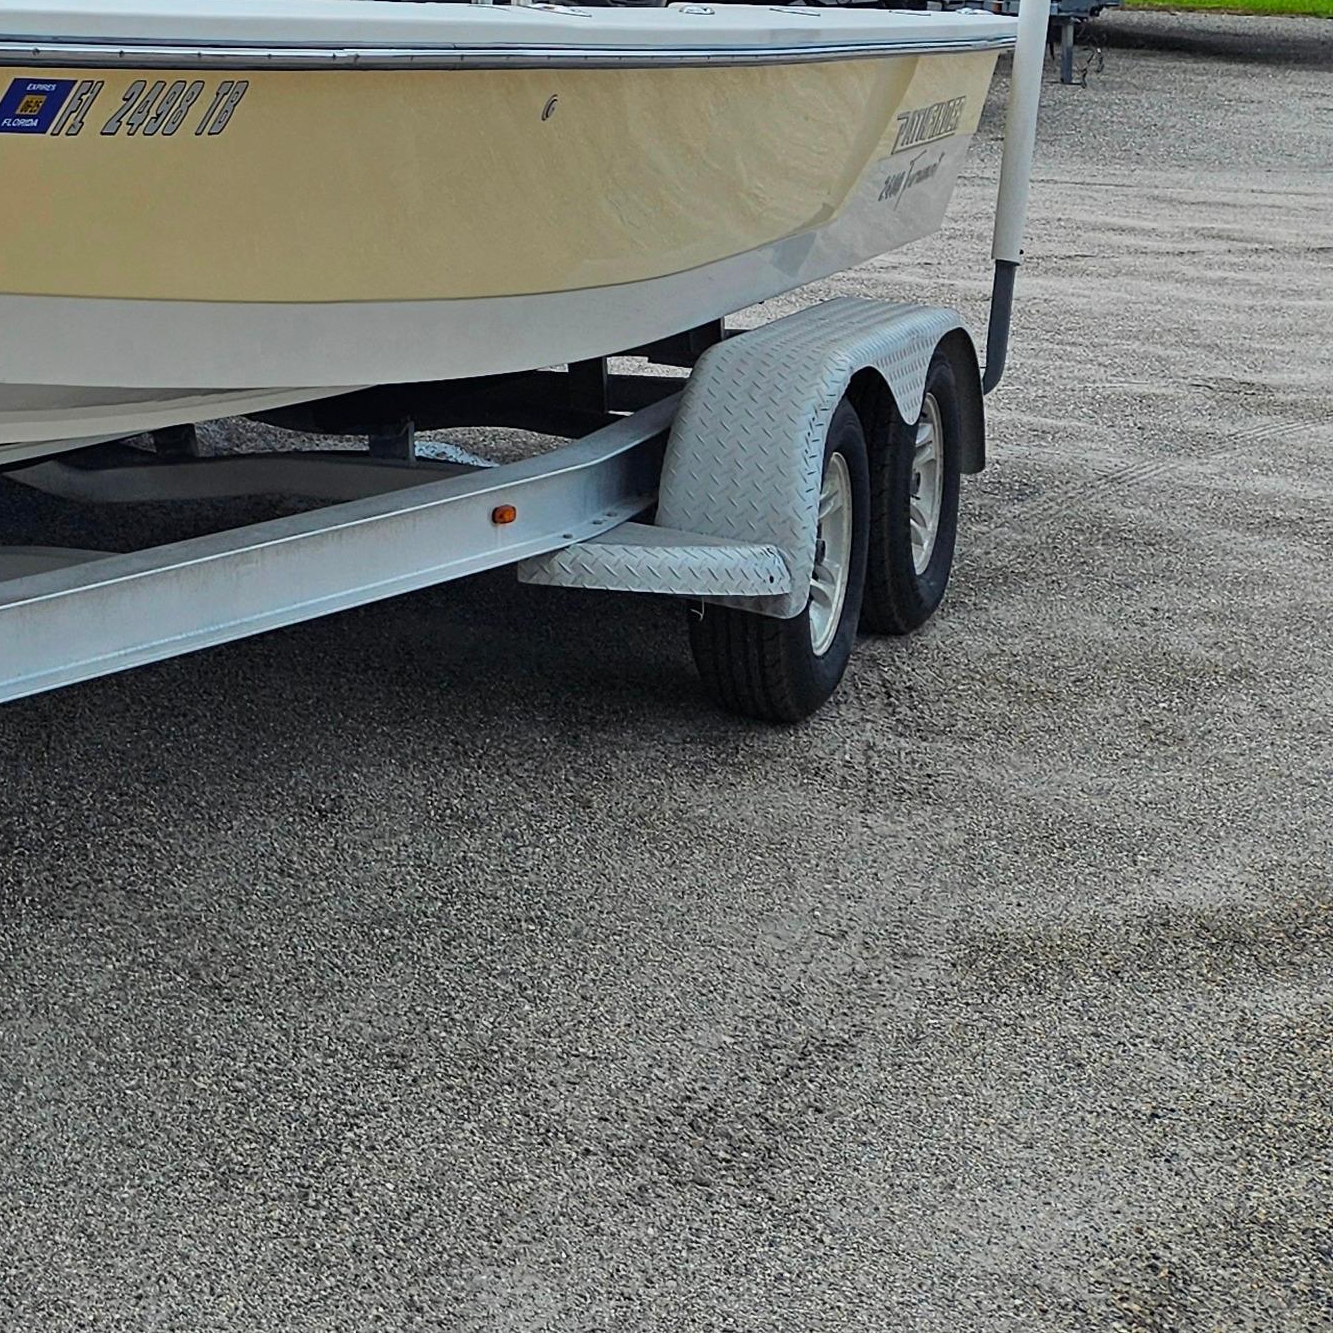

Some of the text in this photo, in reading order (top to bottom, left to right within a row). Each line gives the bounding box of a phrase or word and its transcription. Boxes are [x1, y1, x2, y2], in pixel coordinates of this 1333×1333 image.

[1, 118, 39, 127] FLORIDA
[100, 80, 205, 136] 2498
[195, 80, 249, 136] TB
